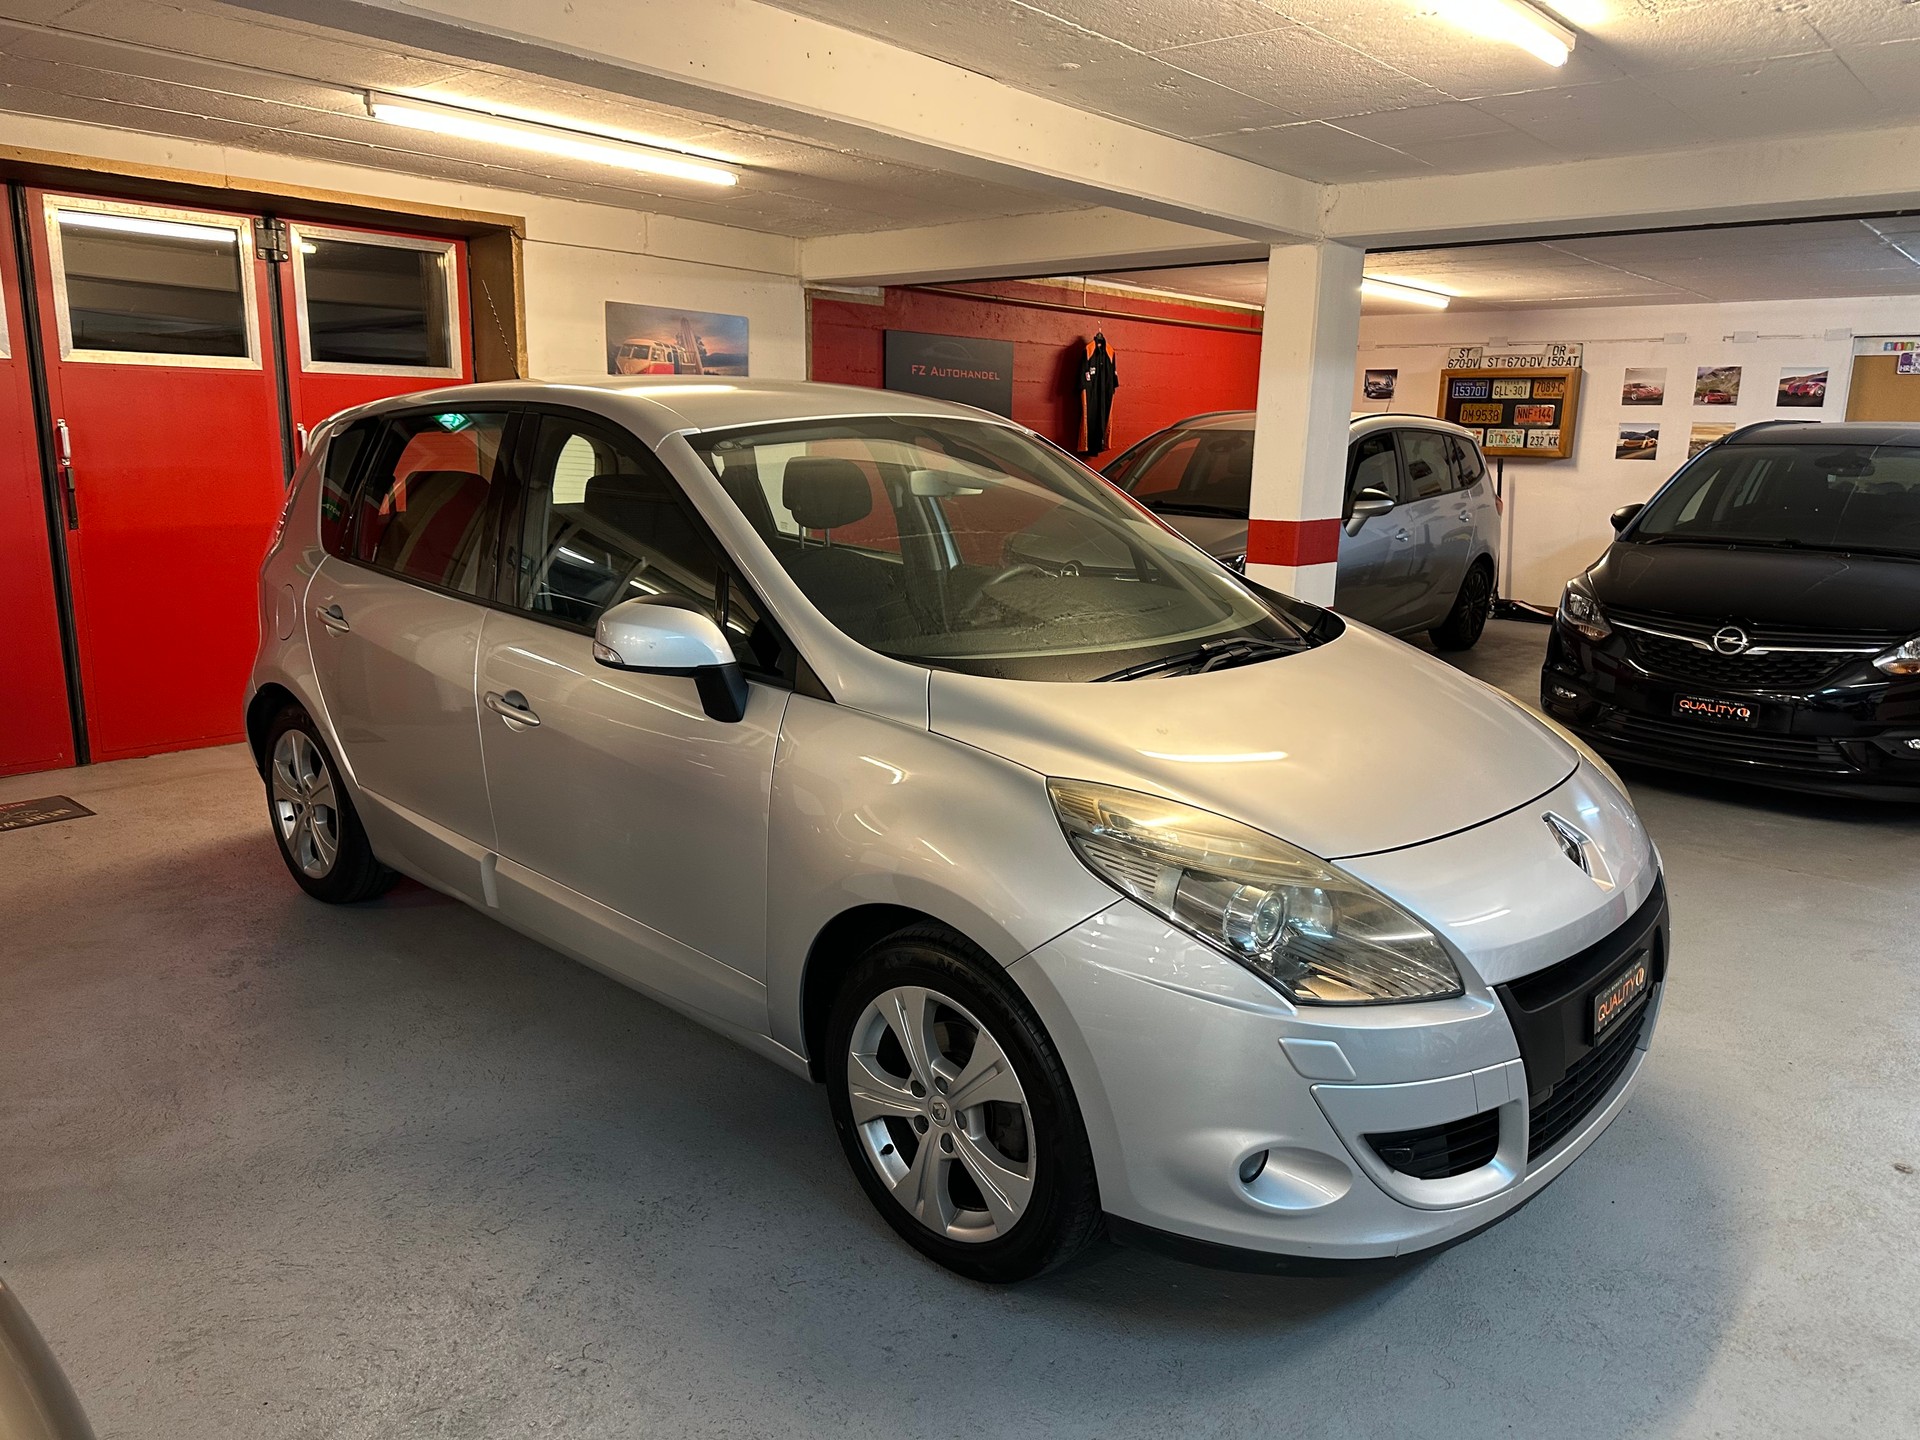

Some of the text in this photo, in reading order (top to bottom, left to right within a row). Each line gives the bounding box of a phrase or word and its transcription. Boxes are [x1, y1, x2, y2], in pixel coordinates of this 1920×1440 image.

[1459, 348, 1471, 359] ST
[1552, 345, 1566, 356] DR
[1487, 357, 1500, 368] ST
[911, 364, 926, 376] FZ
[1529, 435, 1545, 447] 232
[1679, 699, 1737, 715] QUALITY
[1598, 975, 1637, 1022] QUALITY
